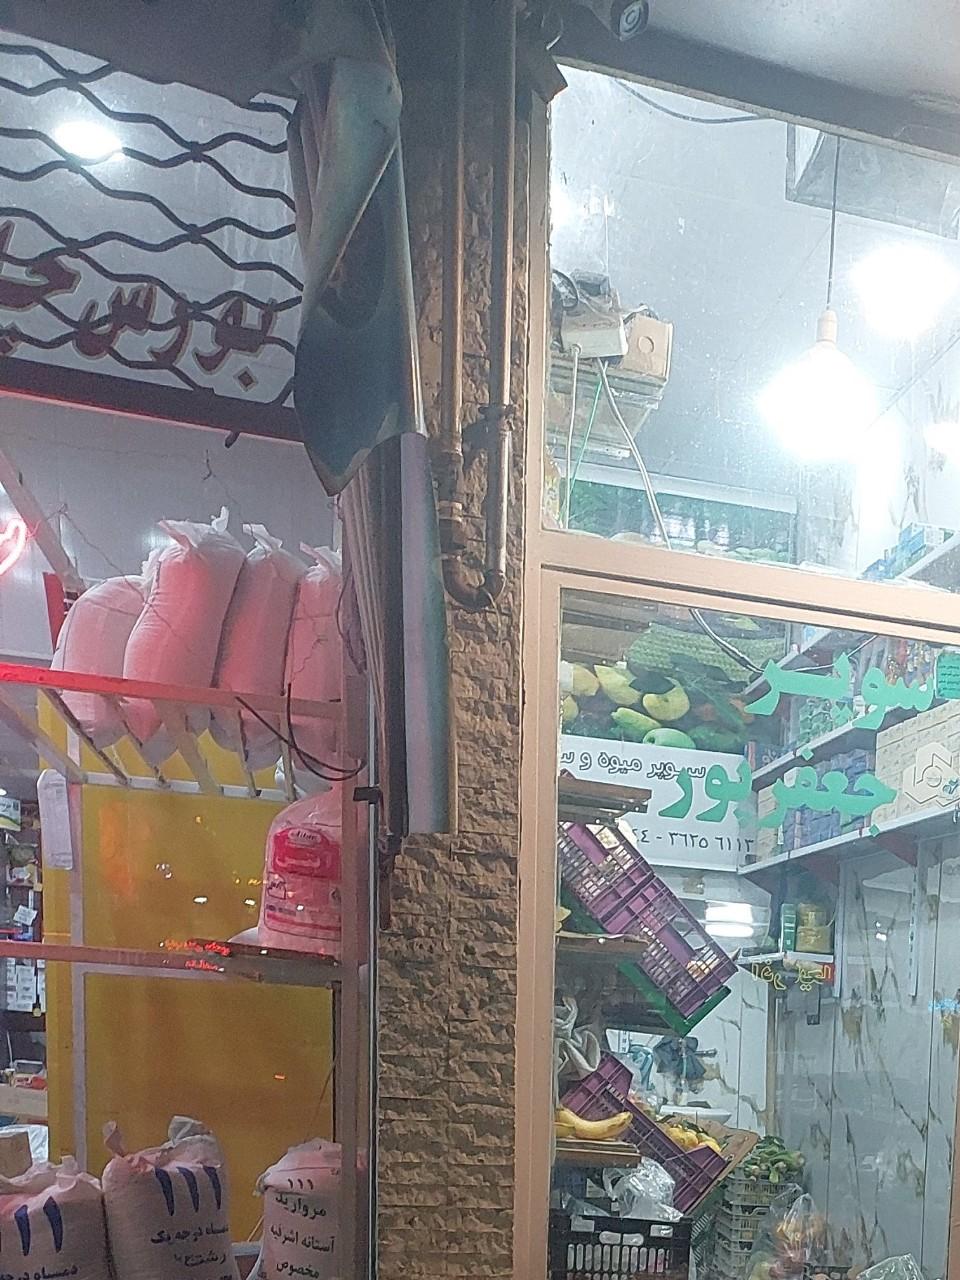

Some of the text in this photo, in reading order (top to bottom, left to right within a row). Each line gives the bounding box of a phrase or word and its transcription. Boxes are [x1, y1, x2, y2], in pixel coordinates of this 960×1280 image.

[744, 652, 935, 731] سوپر
[579, 751, 593, 771] و
[597, 751, 643, 775] میوه
[275, 1191, 327, 1220] مروارید
[301, 1235, 336, 1254] آستانه
[276, 1260, 321, 1279] مخصوص
